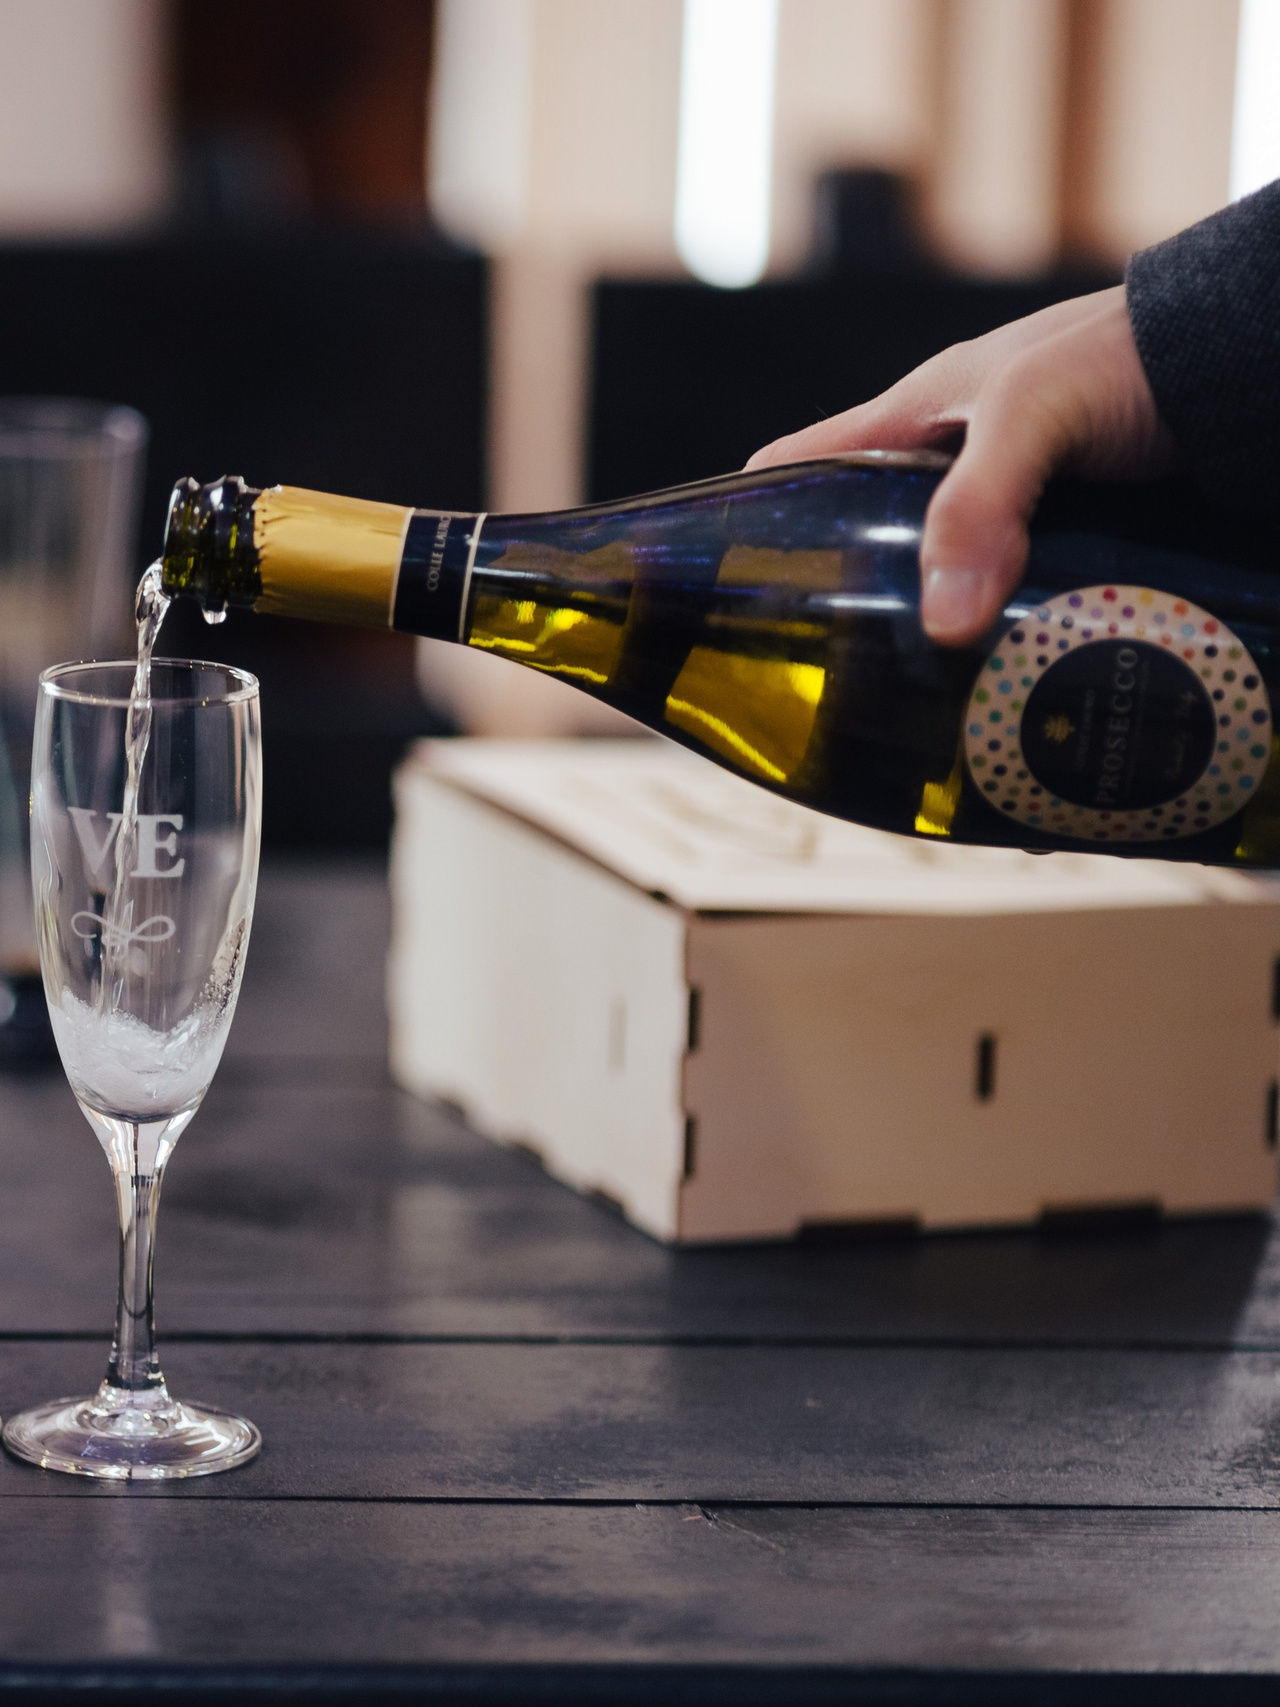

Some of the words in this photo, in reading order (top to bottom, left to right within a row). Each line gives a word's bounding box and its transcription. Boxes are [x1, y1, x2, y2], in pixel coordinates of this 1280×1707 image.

[427, 551, 443, 592] COLLE
[1096, 648, 1139, 804] PROSECCO
[66, 806, 186, 878] VE
